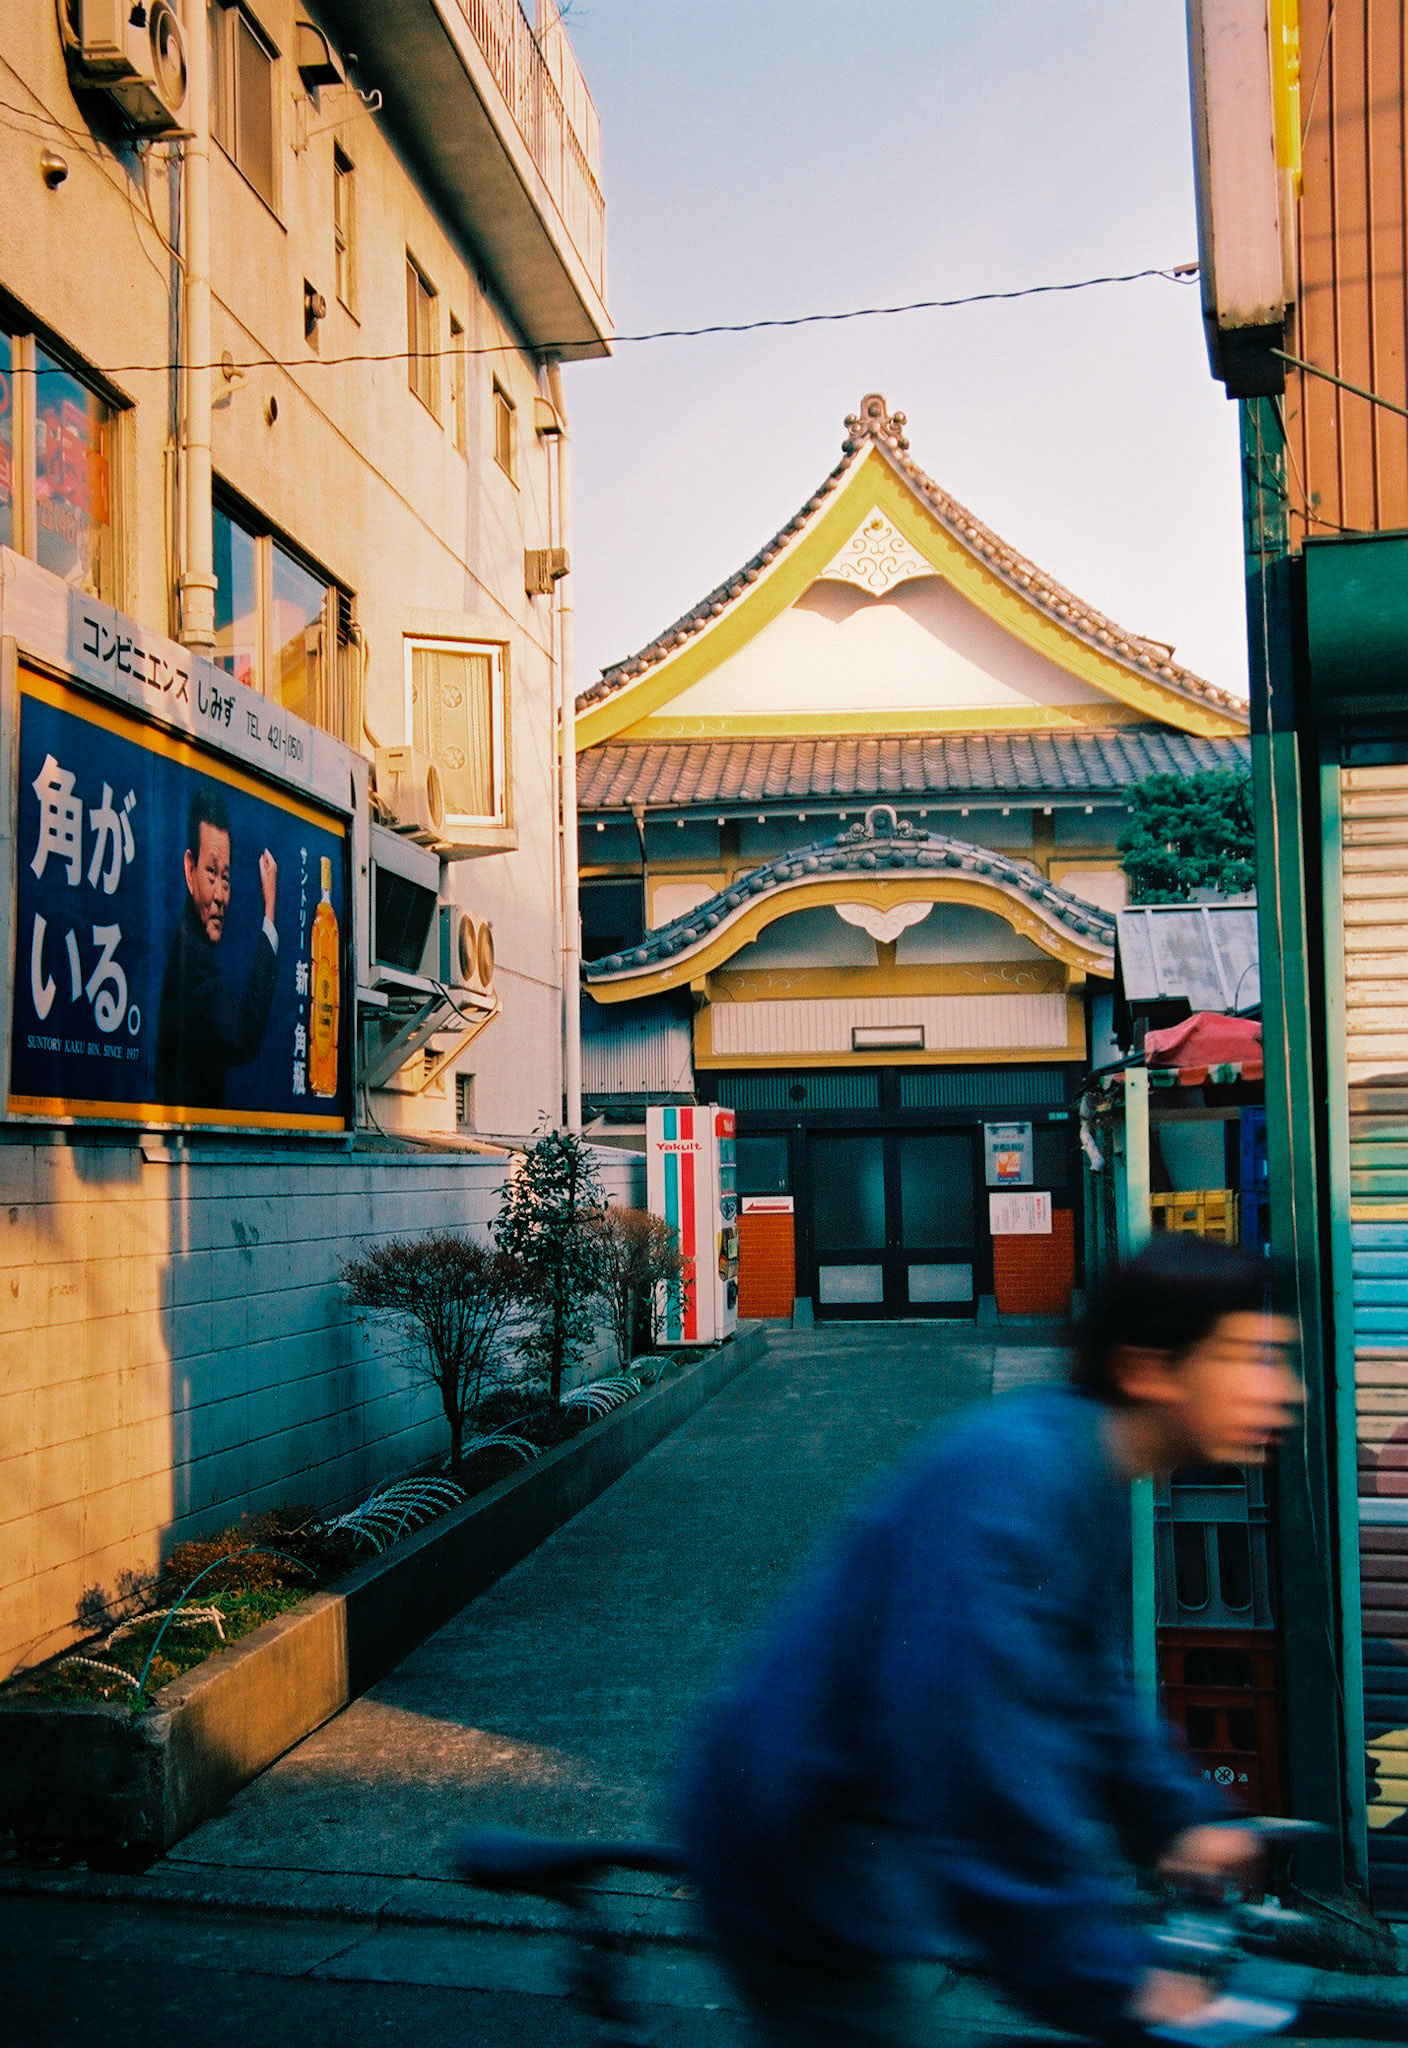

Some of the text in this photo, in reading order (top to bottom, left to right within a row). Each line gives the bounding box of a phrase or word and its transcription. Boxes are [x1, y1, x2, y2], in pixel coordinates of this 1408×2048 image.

[83, 616, 189, 704] コンビニエンス
[198, 679, 236, 728] しみず
[246, 710, 262, 741] TEL
[30, 753, 137, 895] 角が
[299, 846, 309, 950] サントリー
[31, 912, 141, 1037] いる。
[27, 1034, 62, 1052] SUNTORY
[64, 1039, 86, 1055] KAKU
[103, 1044, 123, 1059] SINCE
[126, 1047, 139, 1060] 1937
[656, 1143, 702, 1151] Yakult
